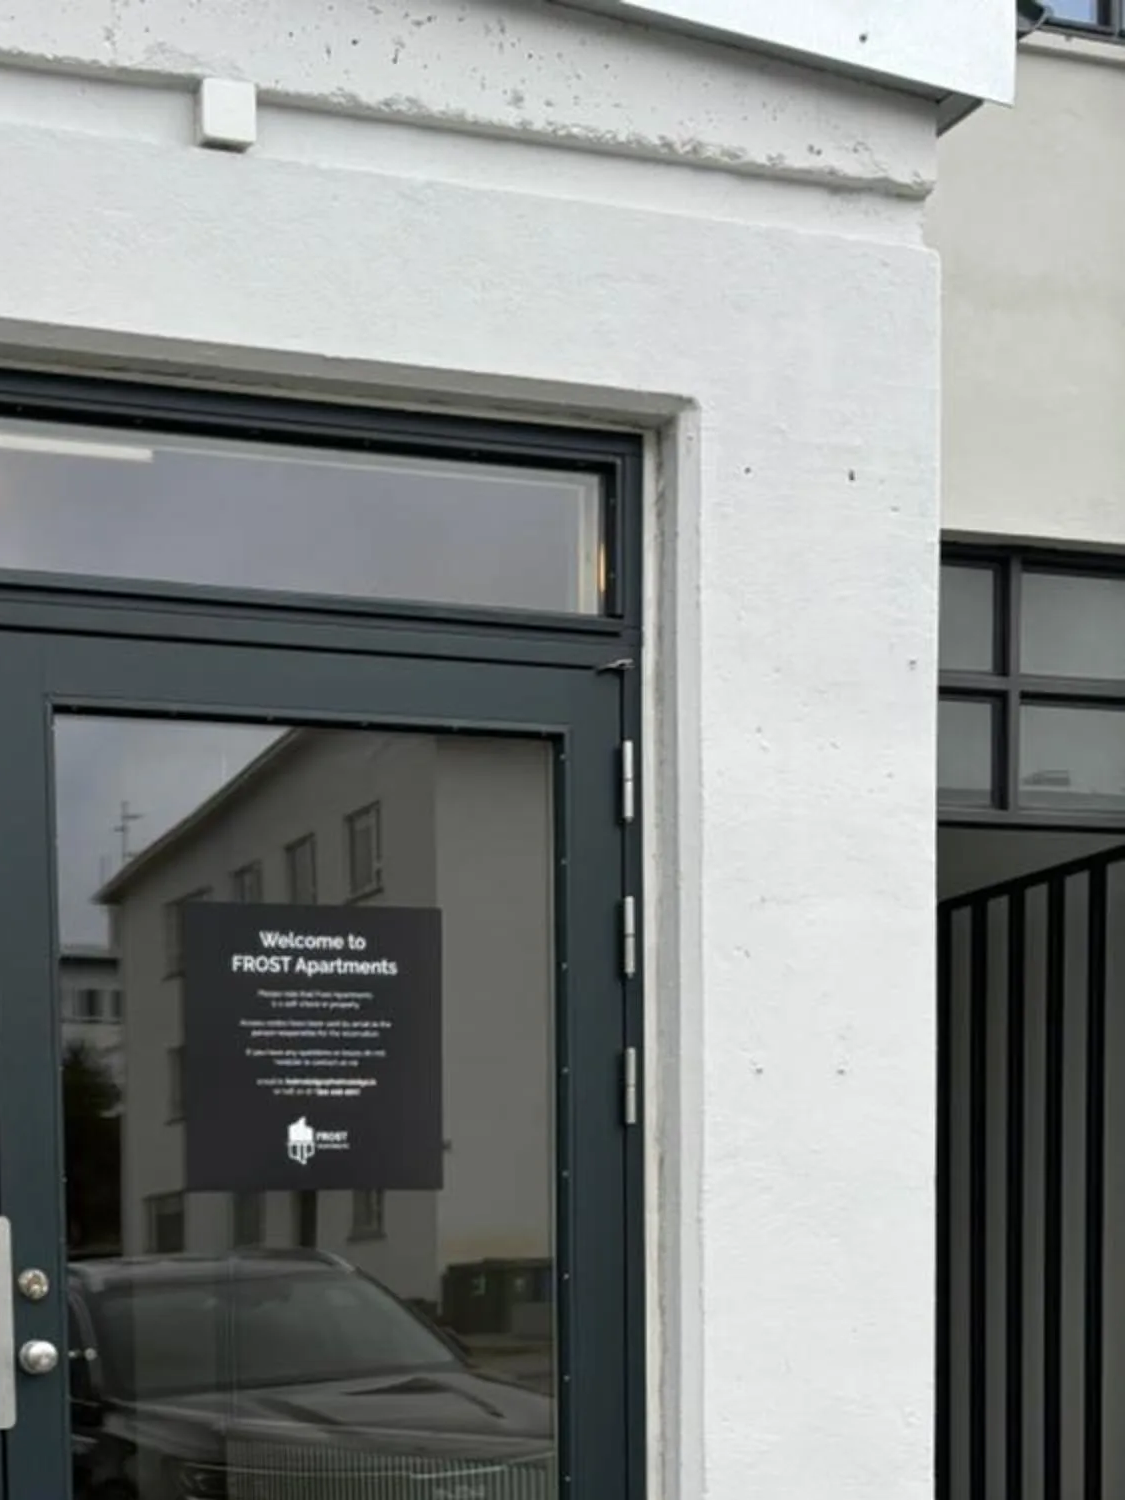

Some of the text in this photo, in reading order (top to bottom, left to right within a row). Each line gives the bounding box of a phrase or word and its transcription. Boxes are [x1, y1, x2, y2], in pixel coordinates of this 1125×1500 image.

[259, 930, 367, 951] Welcome to
[231, 954, 399, 977] FROST Apartments
